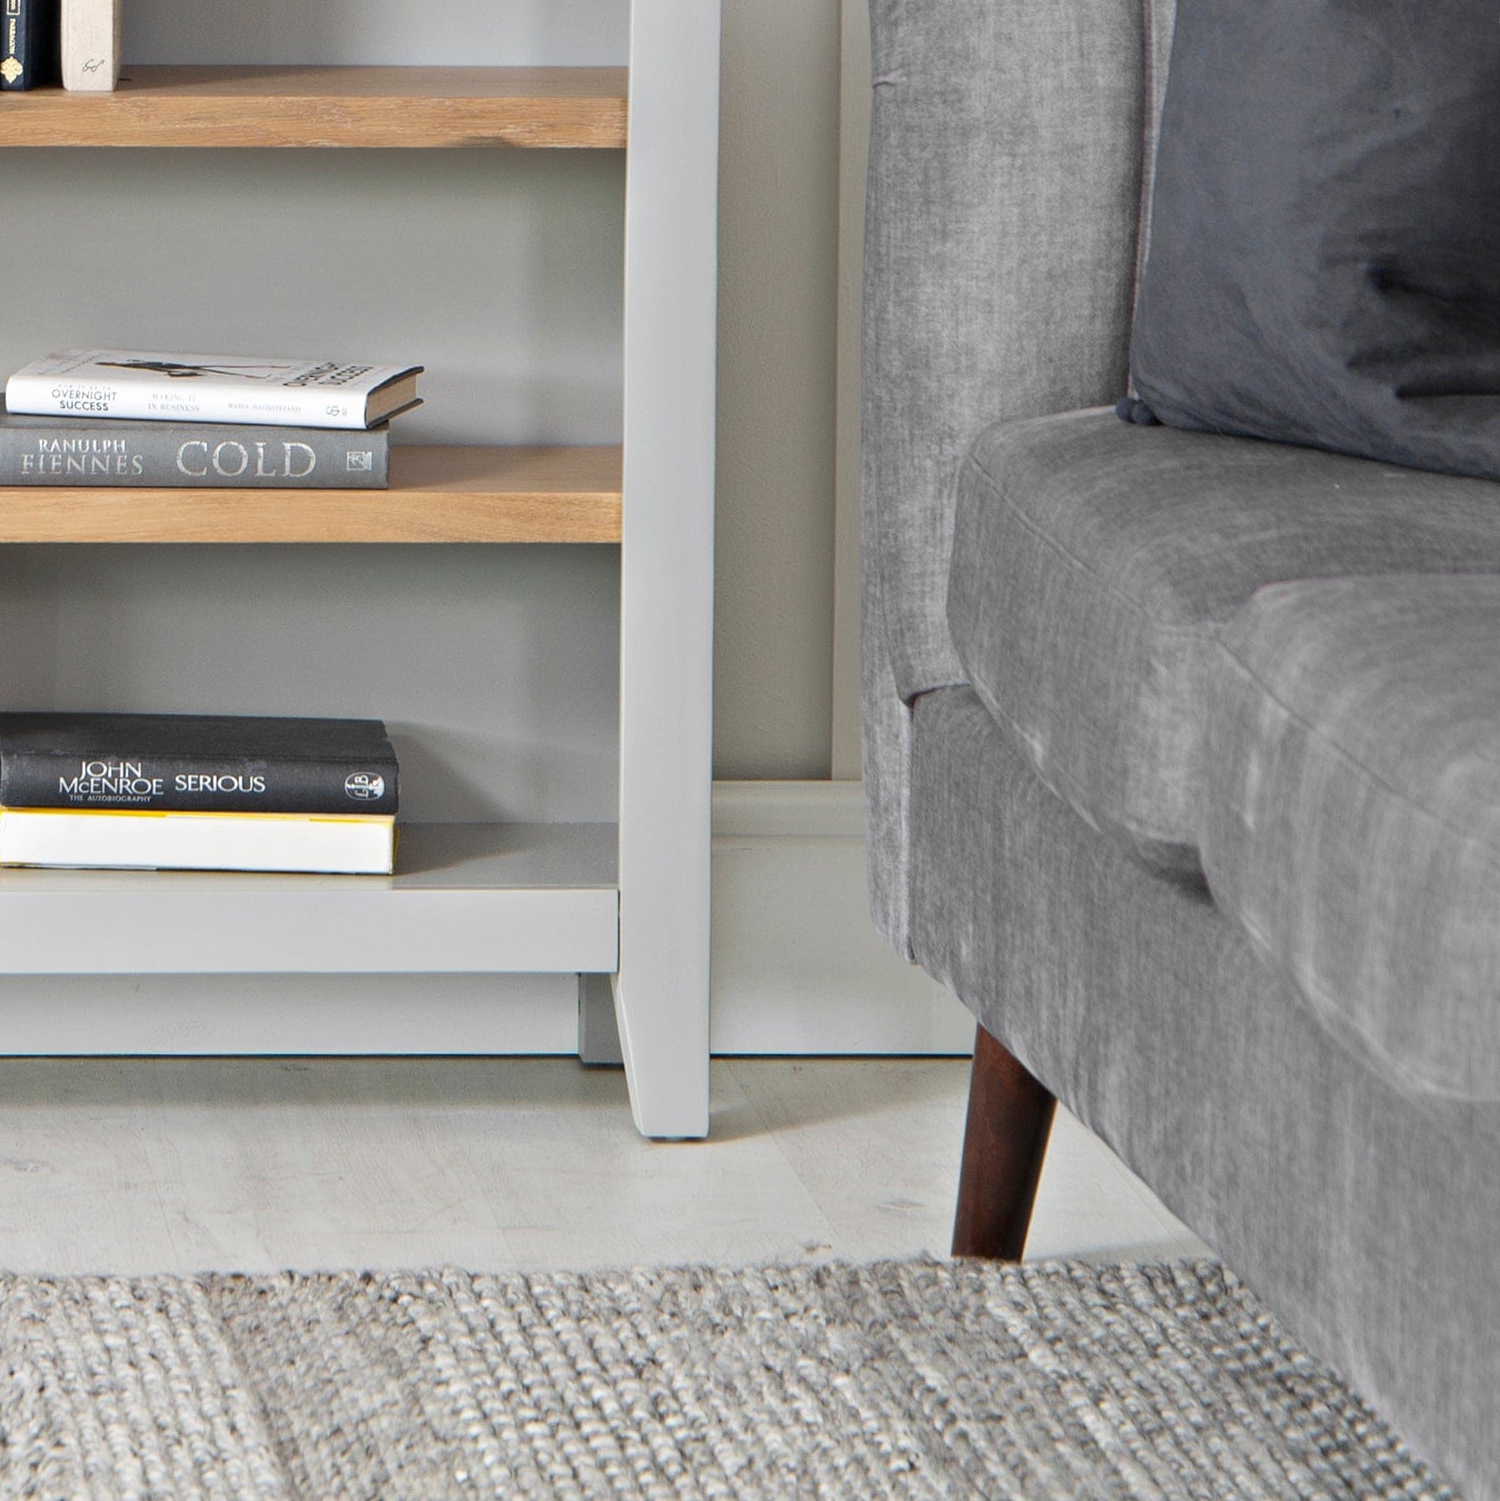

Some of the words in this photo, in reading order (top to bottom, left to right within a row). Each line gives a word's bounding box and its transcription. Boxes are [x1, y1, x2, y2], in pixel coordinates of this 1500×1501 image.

[51, 388, 118, 402] OVERNIGHT
[59, 399, 109, 412] SUCCESS
[38, 438, 128, 455] RANULPH
[20, 452, 144, 476] FIENNES
[175, 441, 317, 478] COLD
[78, 761, 143, 779] JOHN
[59, 776, 165, 796] McENROE
[175, 775, 266, 794] SERIOUS
[69, 794, 85, 802] THE
[87, 794, 152, 803] AUTOBIOGRAPHY
